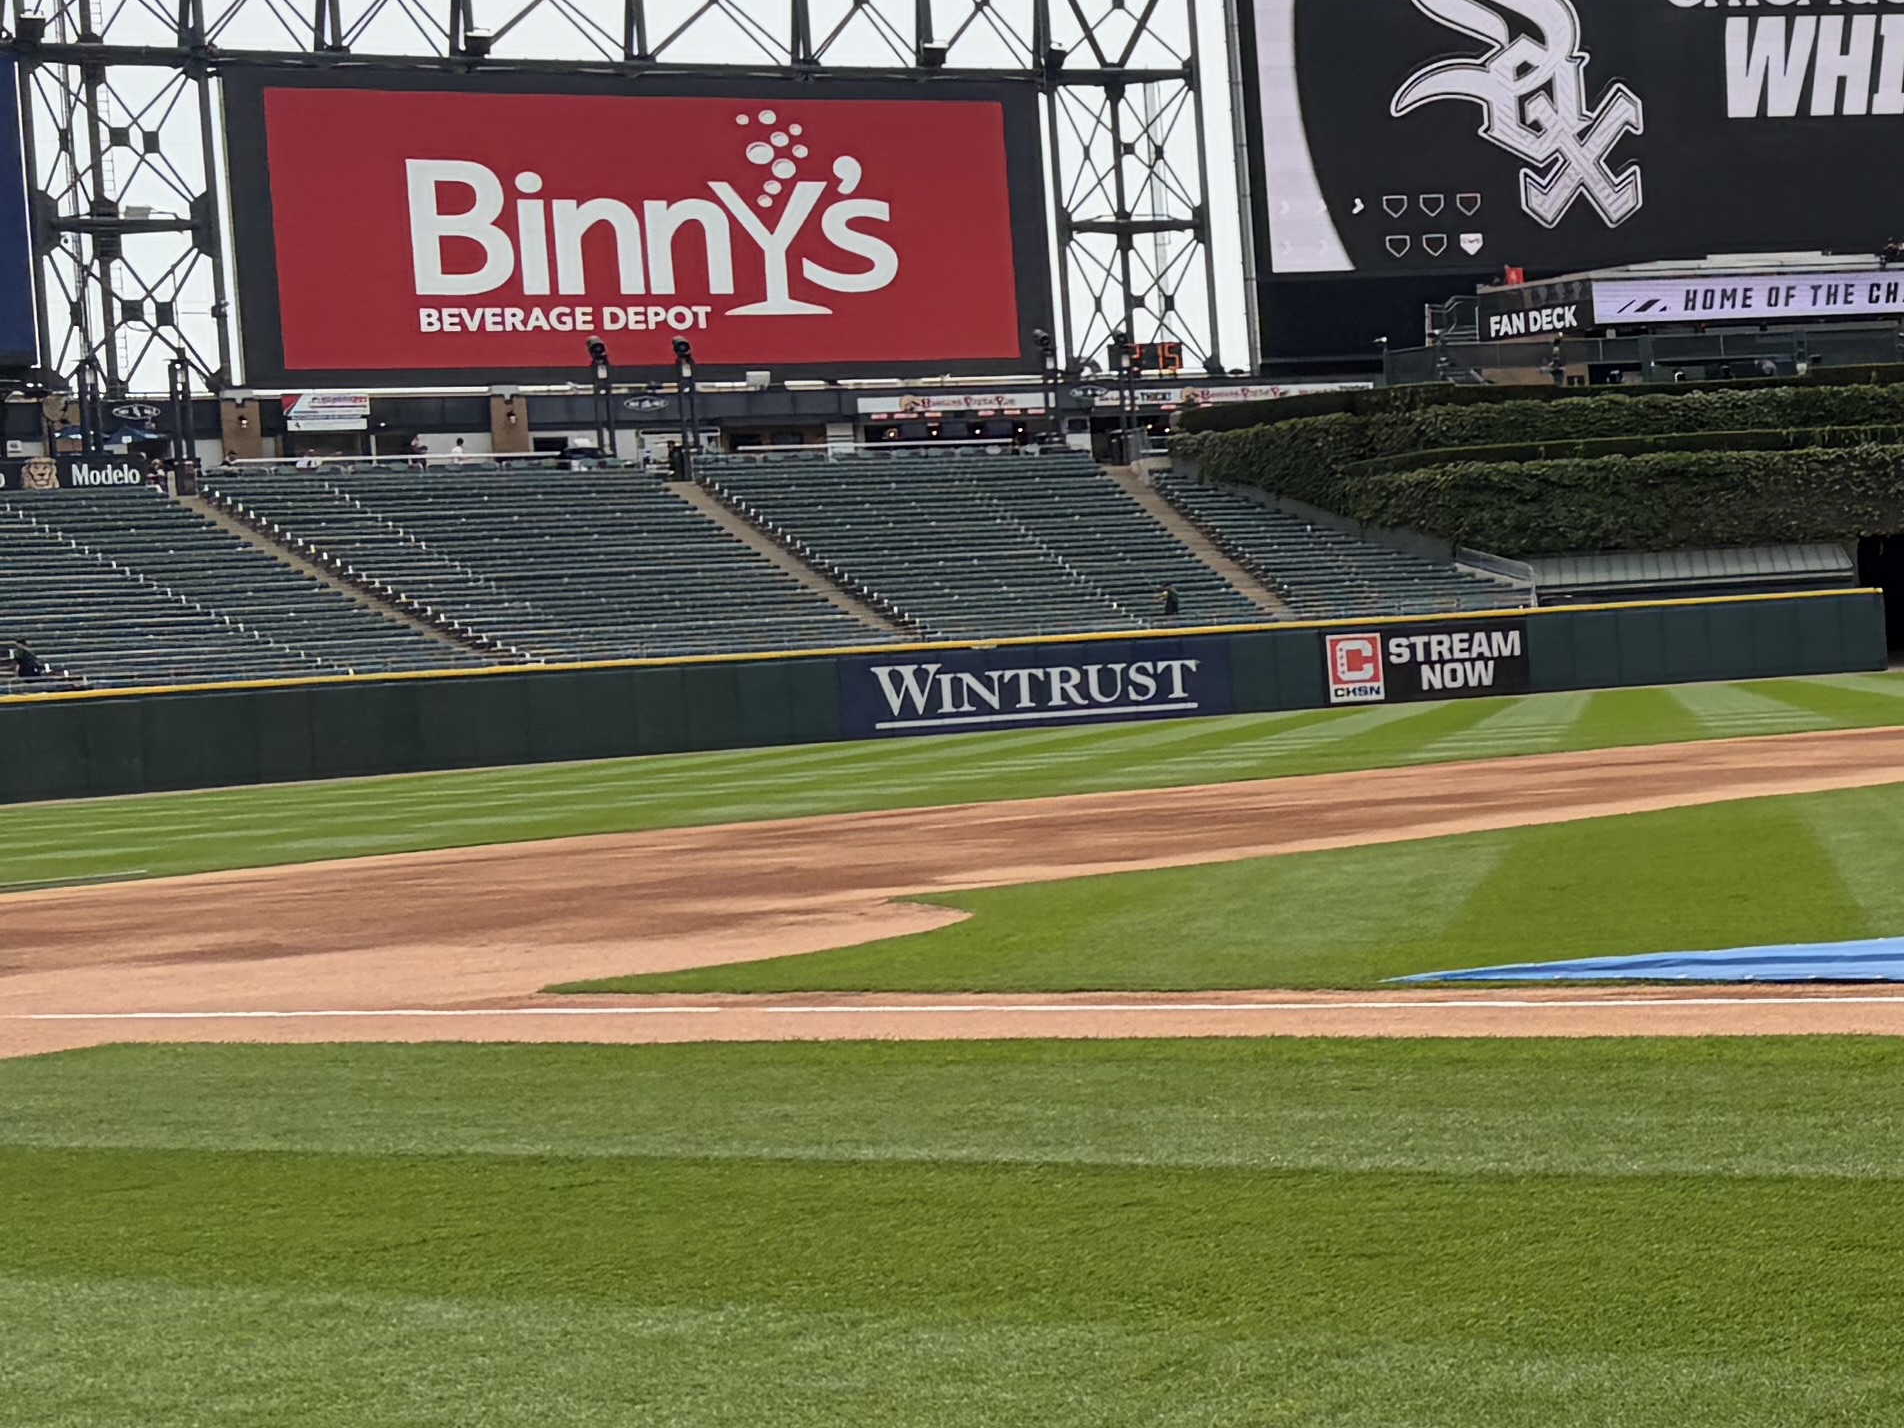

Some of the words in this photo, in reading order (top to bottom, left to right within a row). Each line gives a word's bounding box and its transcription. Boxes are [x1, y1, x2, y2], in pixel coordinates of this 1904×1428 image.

[1684, 287, 1753, 312] HOME
[1767, 285, 1797, 308] OF
[1811, 283, 1856, 307] THE
[419, 305, 594, 333] BEVERAGE
[603, 305, 712, 330] DEPOT
[1489, 310, 1526, 339] FAN
[1529, 305, 1578, 333] DECK
[71, 463, 141, 486] Modelo
[1388, 631, 1521, 665] STREAM
[871, 659, 1199, 717] WINTRUST
[1419, 660, 1496, 692] NOW
[1333, 683, 1382, 700] CHSN
